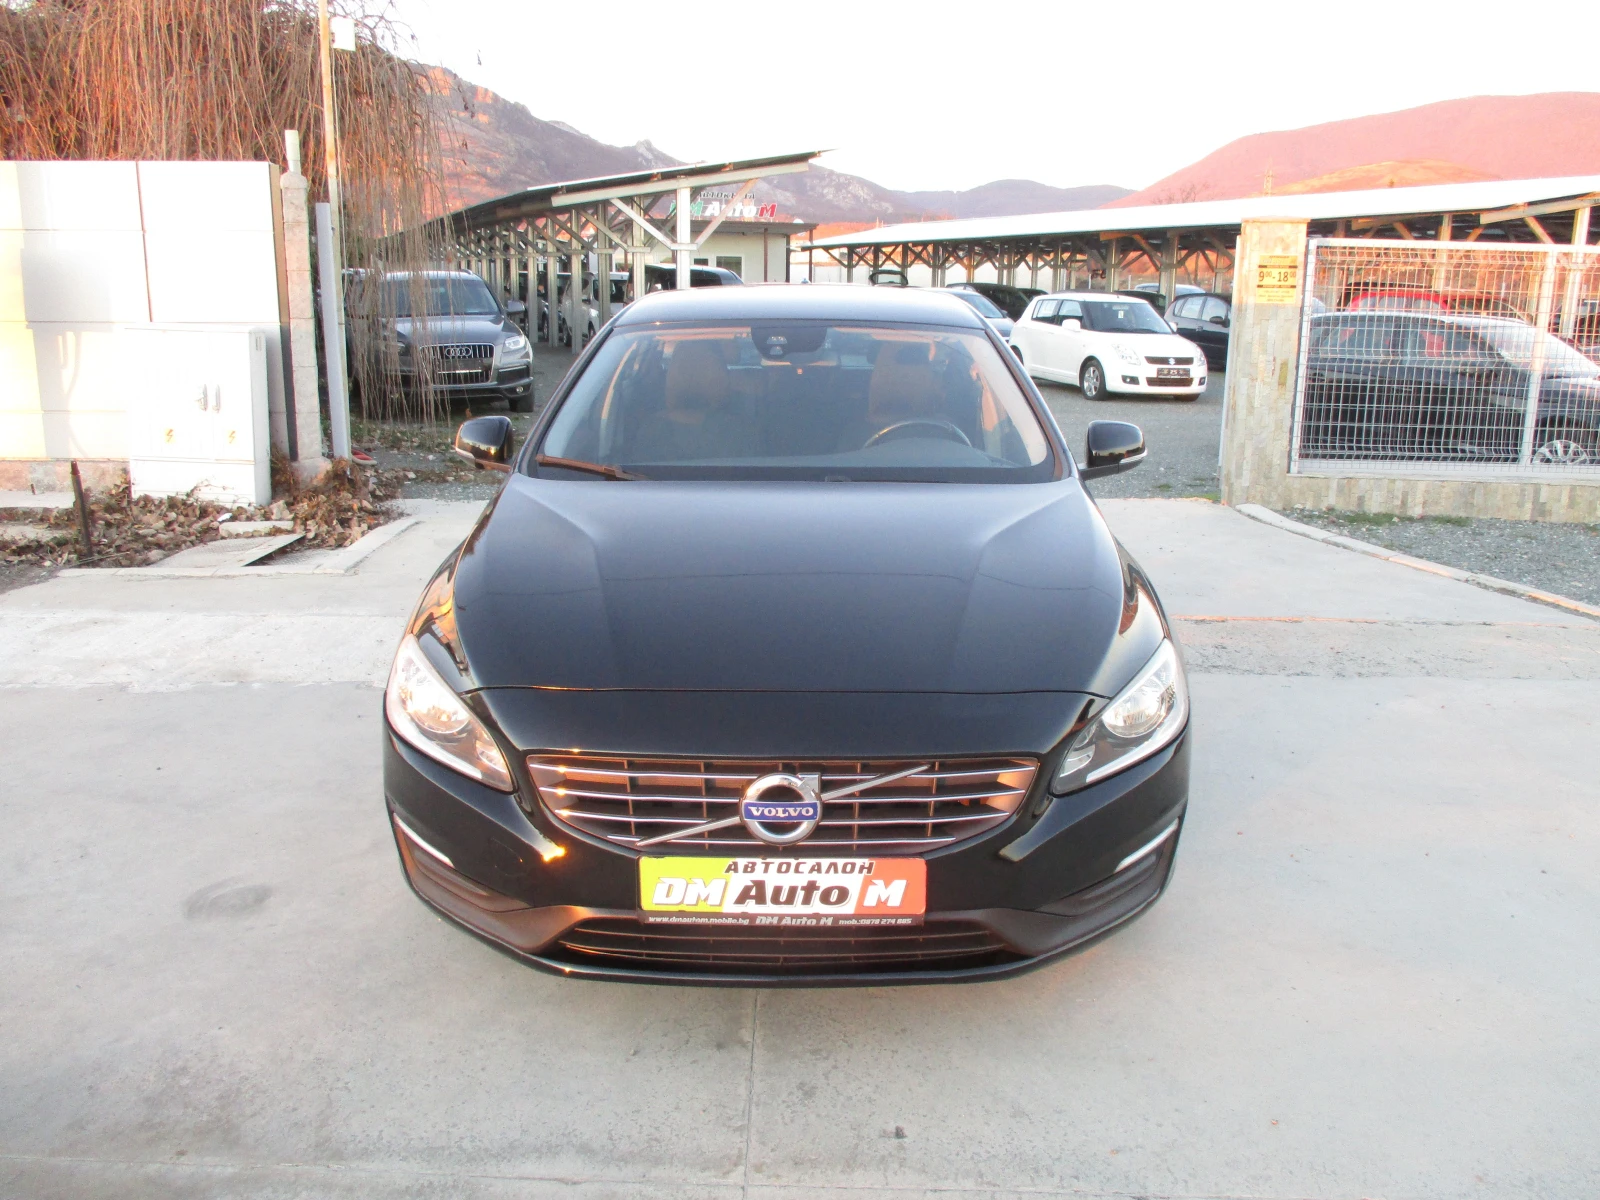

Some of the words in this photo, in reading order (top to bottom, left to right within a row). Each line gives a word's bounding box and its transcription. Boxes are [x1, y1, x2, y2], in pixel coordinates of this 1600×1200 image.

[759, 203, 777, 218] M
[748, 806, 814, 817] VOLVO
[725, 861, 874, 874] АВТОСАЛОН
[653, 877, 726, 905] DM
[733, 880, 851, 906] Auto
[862, 879, 907, 907] M
[755, 916, 779, 925] DM
[781, 916, 817, 926] Auto
[819, 916, 833, 926] M
